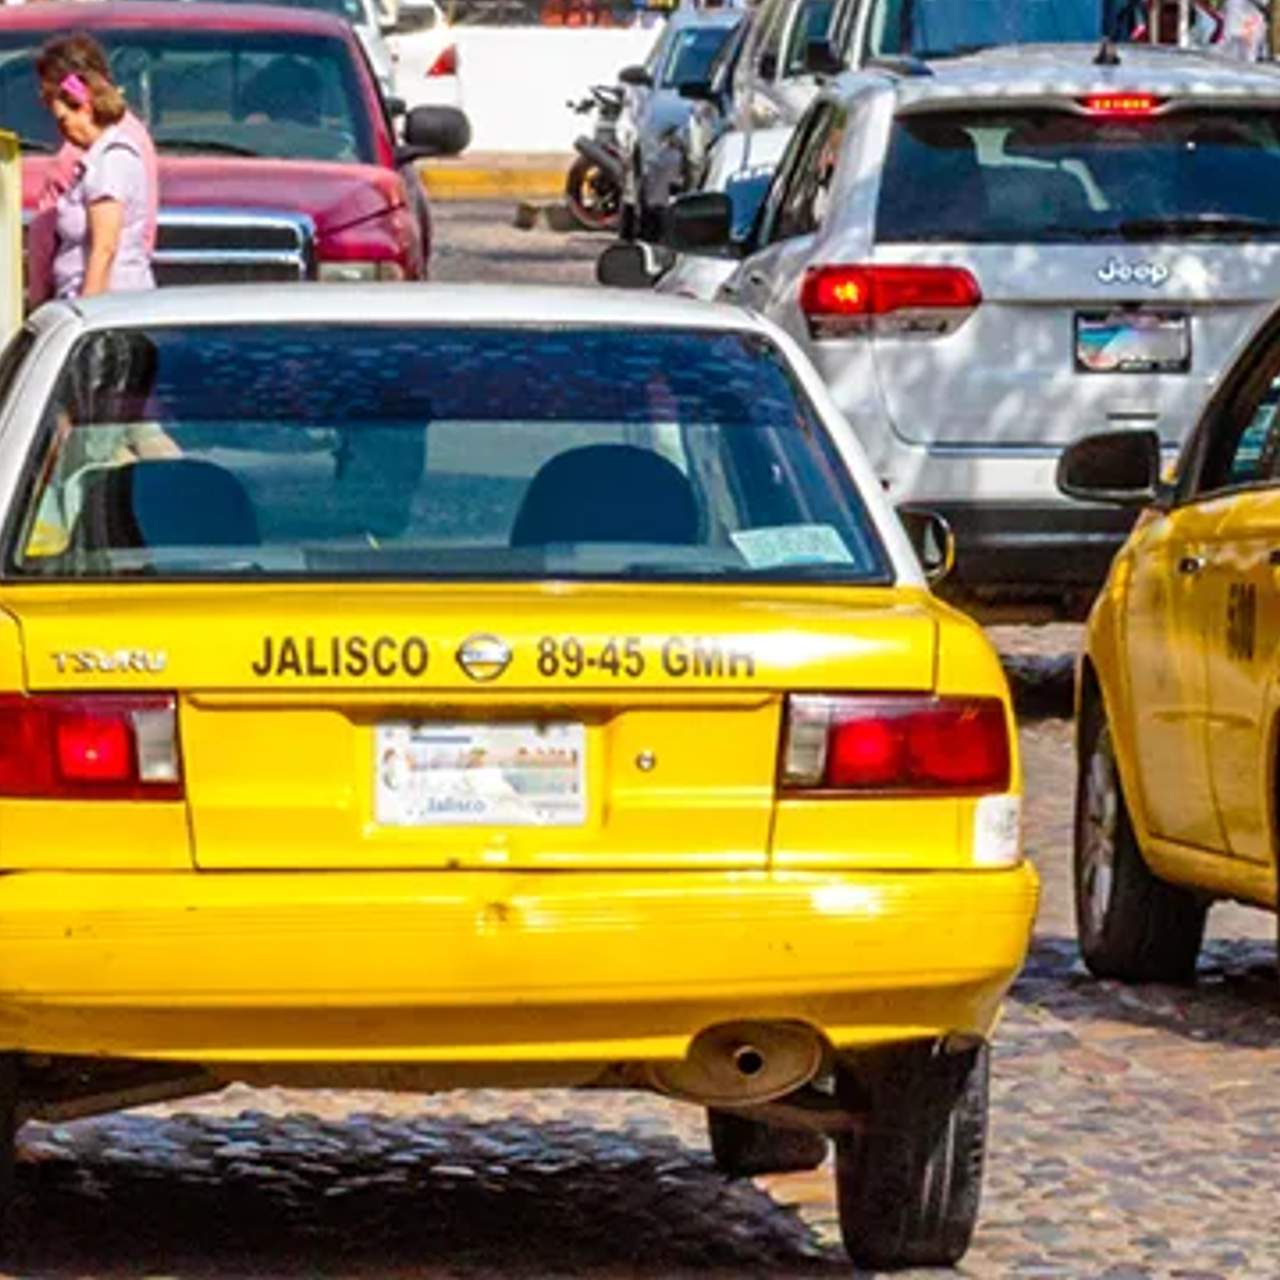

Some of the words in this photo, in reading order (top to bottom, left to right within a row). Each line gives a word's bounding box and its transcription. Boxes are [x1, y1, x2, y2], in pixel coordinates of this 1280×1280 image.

[1097, 259, 1169, 286] Jeep
[51, 648, 168, 674] TSURU
[251, 635, 430, 678] JALISCO
[536, 636, 646, 678] 89-45
[660, 636, 756, 679] GMH
